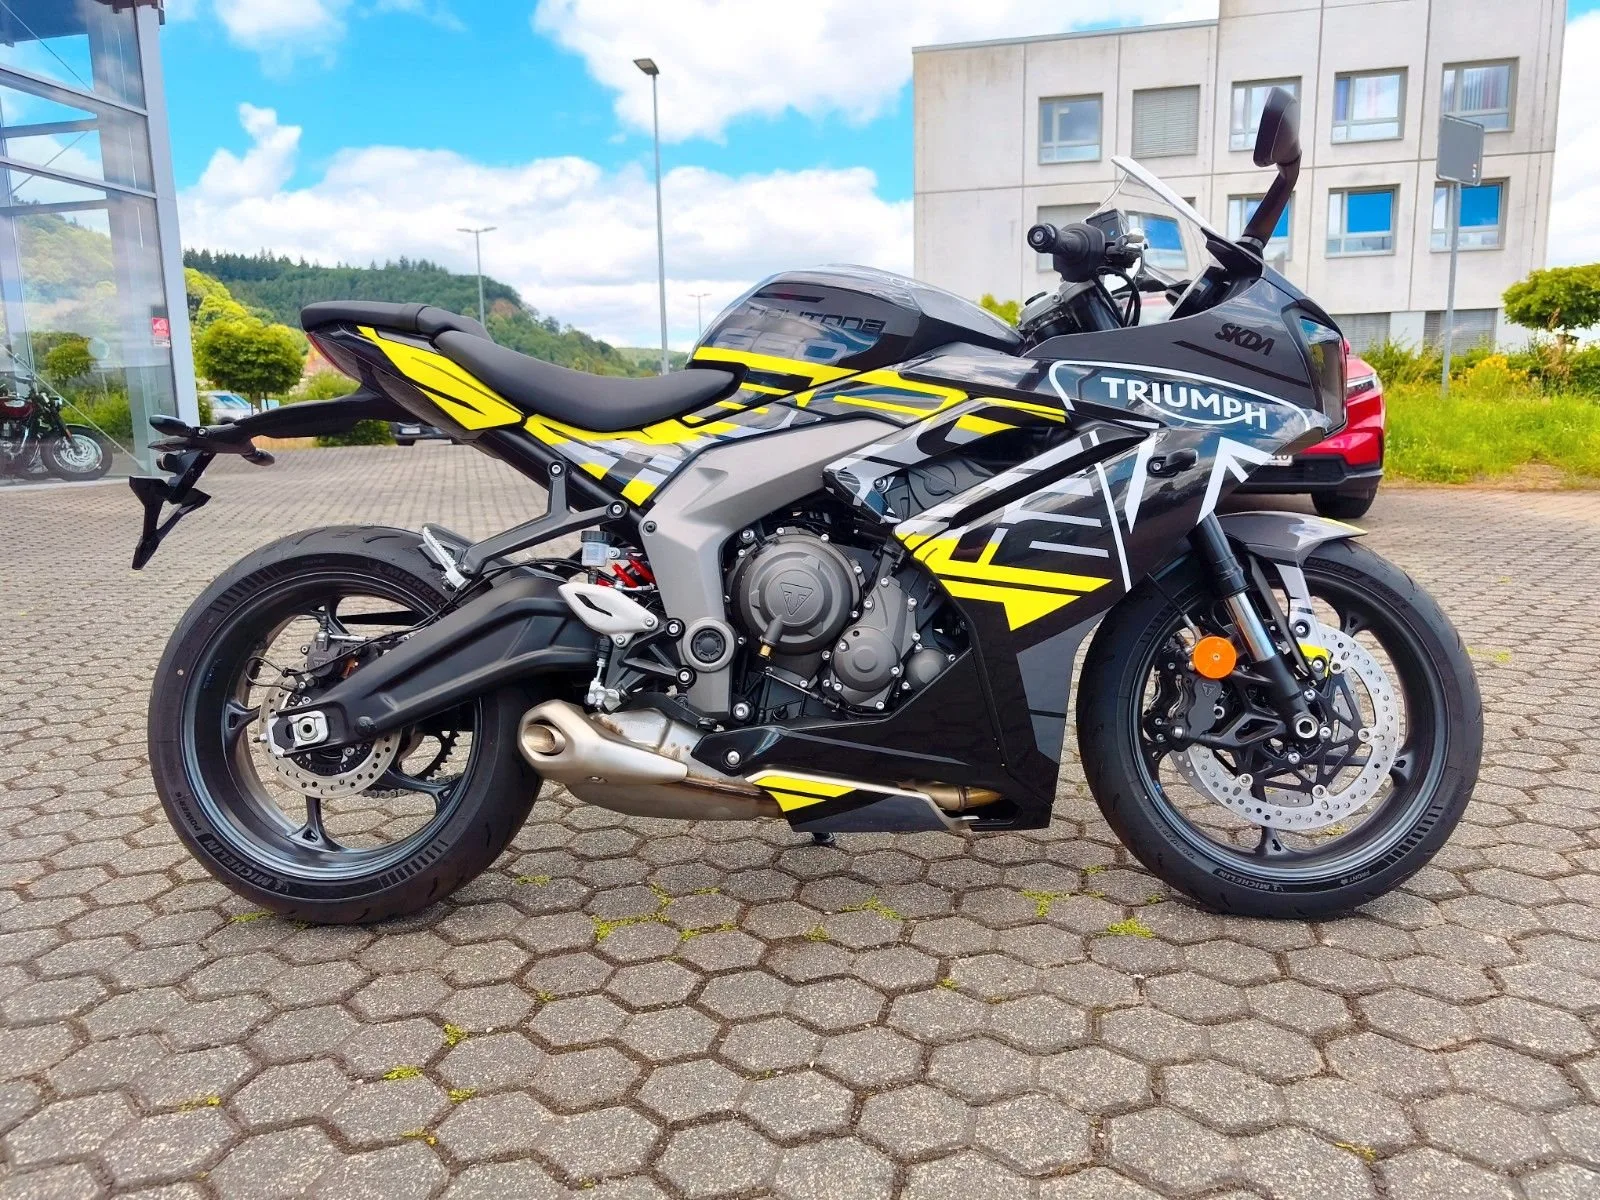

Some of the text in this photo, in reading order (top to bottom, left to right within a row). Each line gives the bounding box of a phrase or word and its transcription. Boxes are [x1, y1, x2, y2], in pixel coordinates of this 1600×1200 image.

[1214, 322, 1275, 356] SKDA
[1101, 377, 1267, 429] TRIUMPH
[203, 837, 273, 886] MICHELIN
[1218, 870, 1271, 890] MICHELIN
